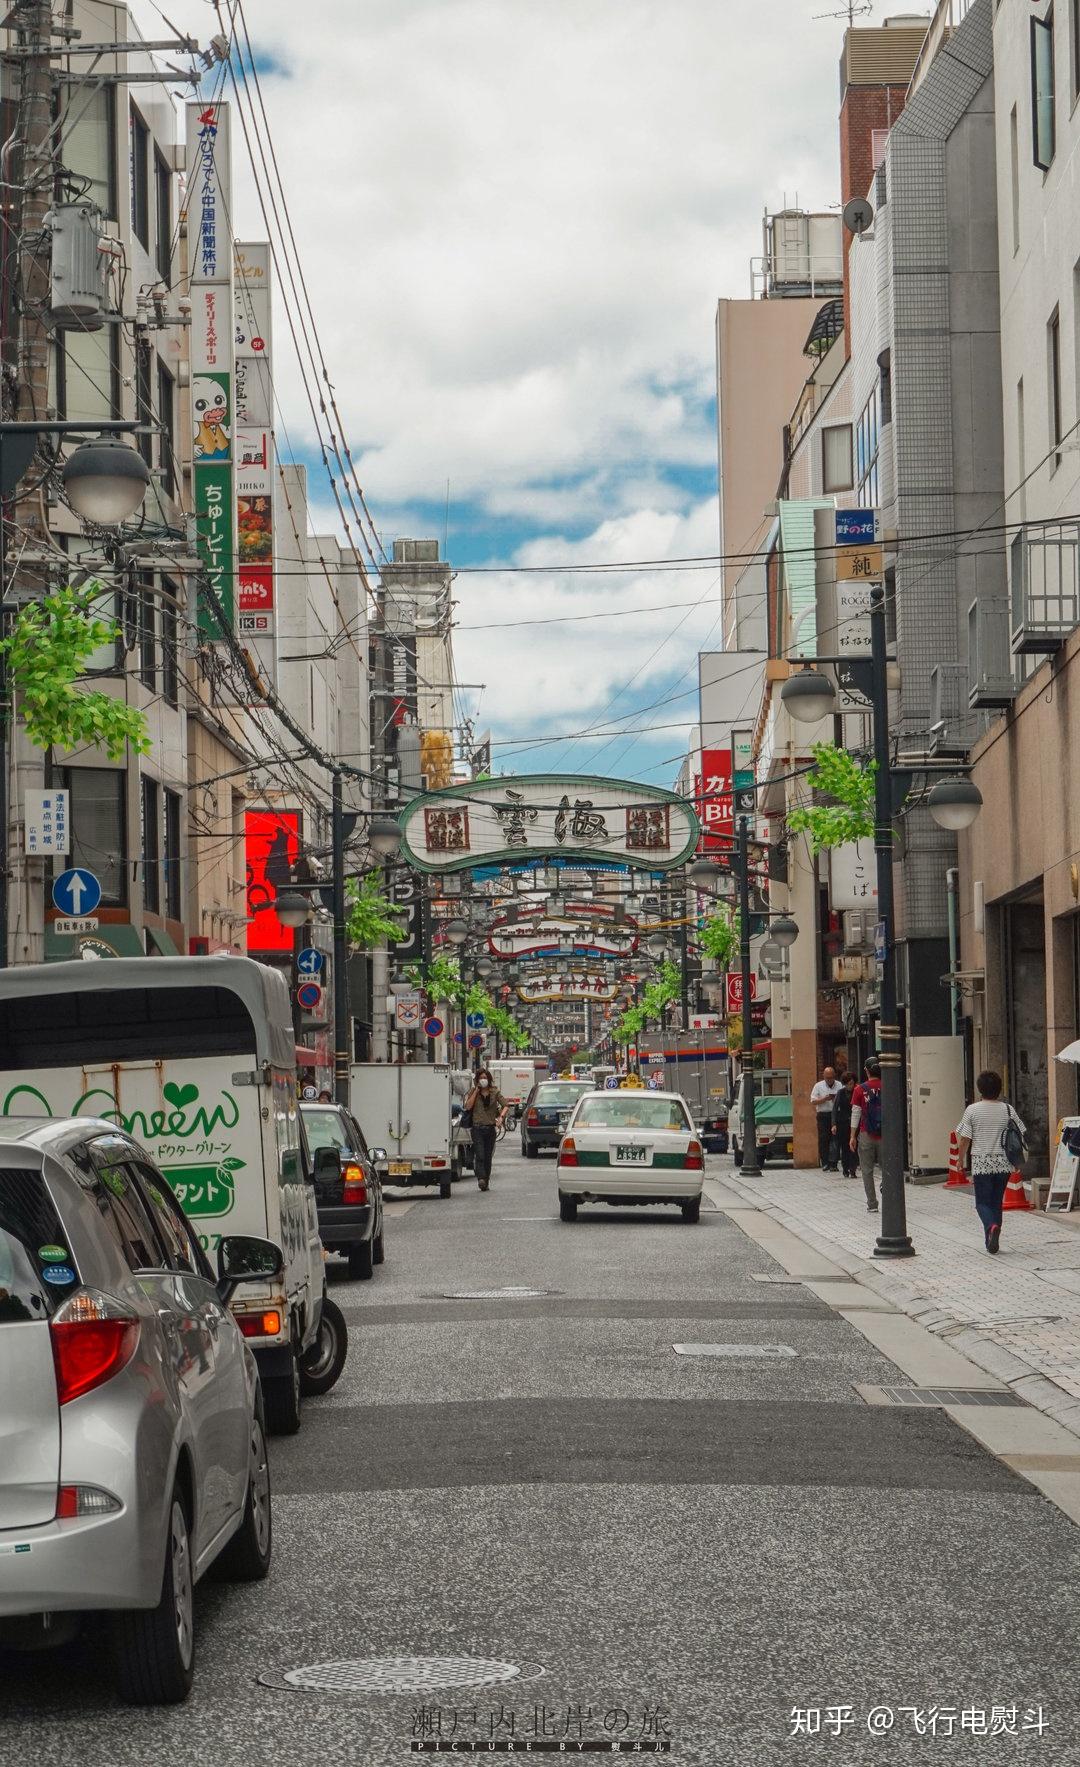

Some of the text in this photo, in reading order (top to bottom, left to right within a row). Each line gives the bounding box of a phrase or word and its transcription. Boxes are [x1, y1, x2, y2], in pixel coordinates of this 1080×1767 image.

[43, 800, 52, 845] 重点地域
[56, 793, 65, 851] 違法駐車防止
[56, 921, 97, 931] 自転車を除く
[158, 1140, 232, 1158] ドクターグリーン
